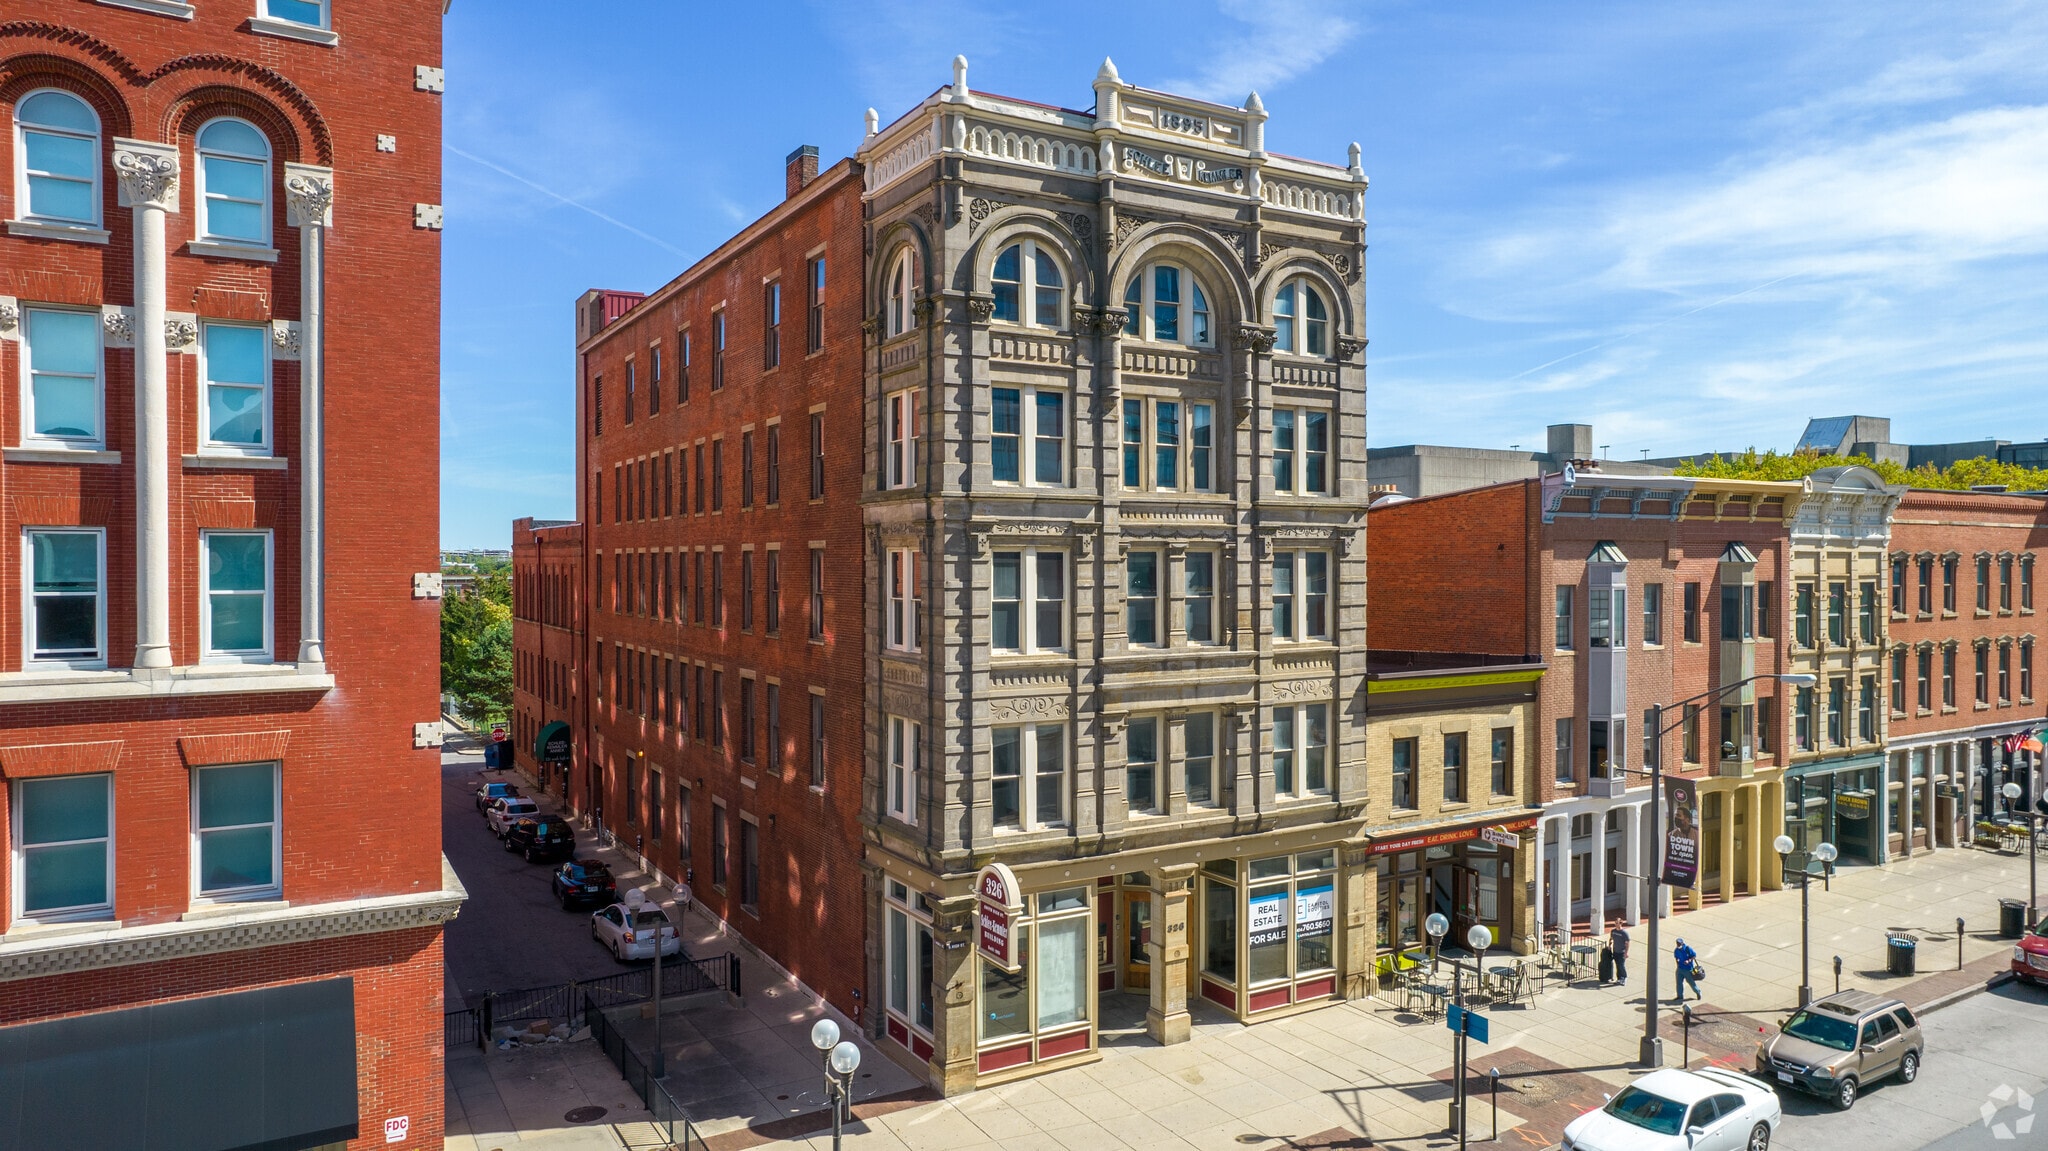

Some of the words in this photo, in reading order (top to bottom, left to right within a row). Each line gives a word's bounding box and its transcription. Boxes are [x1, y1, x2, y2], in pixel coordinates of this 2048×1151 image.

[1162, 113, 1204, 134] 1895
[1126, 147, 1171, 177] SCHLEE
[1459, 829, 1476, 839] LOVE.
[1669, 835, 1695, 847] DOWN
[1670, 842, 1694, 853] TOWN
[1678, 851, 1694, 859] open
[985, 877, 1003, 900] 326
[1257, 903, 1279, 915] REAL
[1307, 900, 1329, 908] CAPITOL
[1253, 914, 1283, 927] ESTATE
[984, 930, 1004, 947] BUILDING
[1249, 934, 1266, 946] FOR
[1266, 930, 1287, 942] SALE
[386, 1118, 407, 1132] FDC
